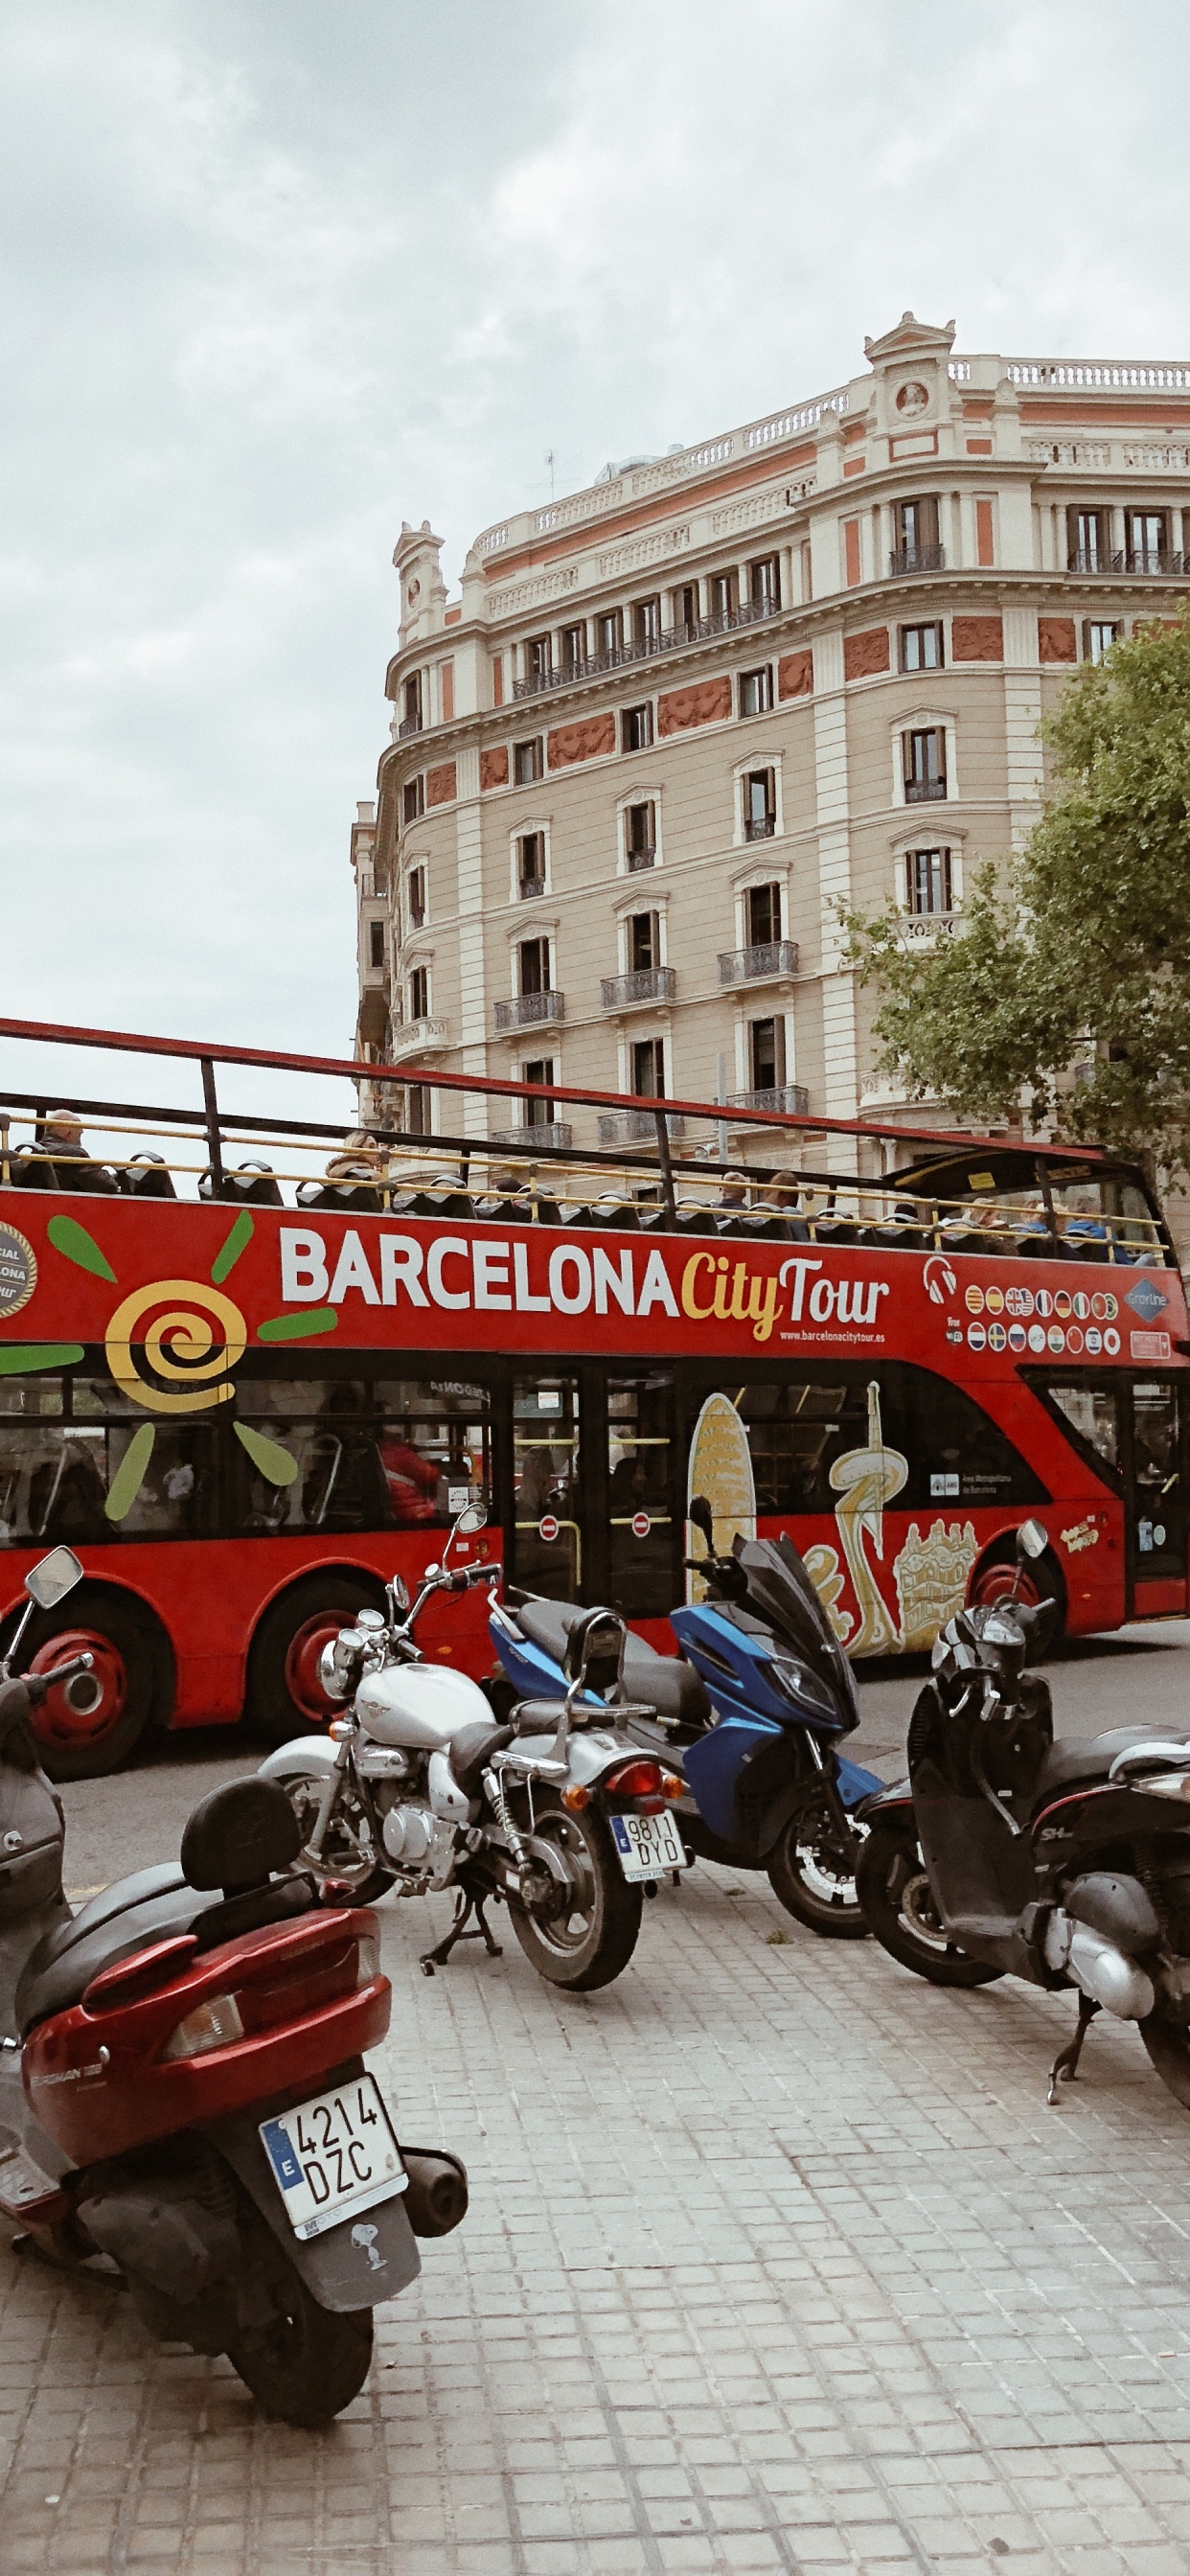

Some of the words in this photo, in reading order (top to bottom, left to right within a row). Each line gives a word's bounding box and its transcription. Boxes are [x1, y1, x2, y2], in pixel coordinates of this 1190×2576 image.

[0, 1266, 26, 1280] ONA
[280, 1227, 680, 1317] BARCELONA
[681, 1252, 784, 1342] City
[779, 1257, 890, 1323] Tour
[780, 1329, 885, 1344] www.barcelonacitytour.es
[629, 1816, 673, 1842] 9811
[620, 1838, 628, 1847] E
[637, 1840, 678, 1865] DYD
[297, 2087, 378, 2153] 4214
[281, 2159, 295, 2177] E
[303, 2141, 373, 2204] DZC
